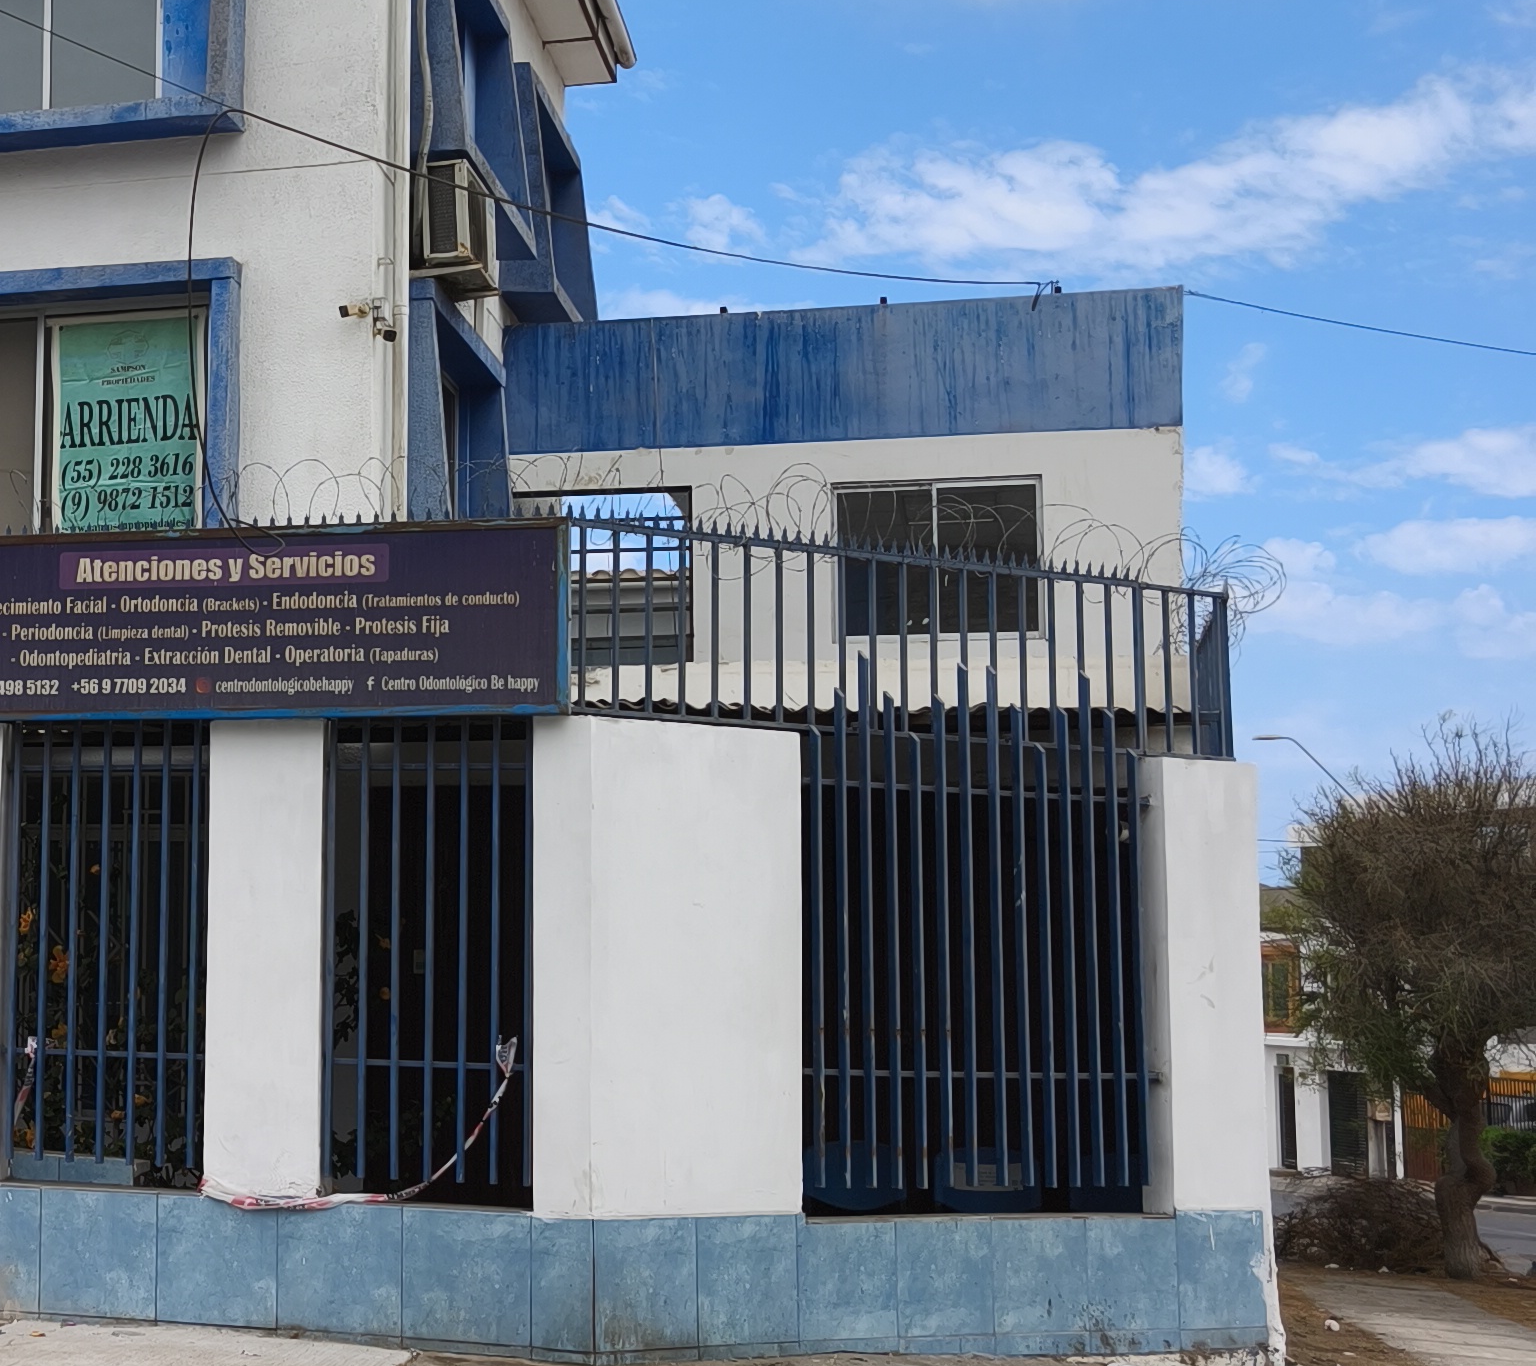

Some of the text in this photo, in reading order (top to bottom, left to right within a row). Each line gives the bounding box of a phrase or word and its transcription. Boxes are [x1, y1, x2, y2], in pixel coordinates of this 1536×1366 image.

[101, 375, 155, 386] PROPIEDADES
[111, 364, 146, 374] SAMPSON
[60, 393, 198, 449] ARRIENDA
[61, 453, 195, 491] (55) 228 3616
[61, 485, 194, 522] (9) 9872 1512
[76, 550, 376, 583] Atenciones y Servicios
[66, 596, 107, 614] Facial
[120, 594, 198, 614] Ortodoncia
[202, 596, 260, 614] (Brackets)
[272, 590, 357, 611] Endodoncia
[362, 593, 442, 610] (Tratamientos
[444, 592, 459, 606] de
[462, 591, 520, 608] conducto)
[11, 615, 449, 642] Periodoncia (Limpieza dental) Protesis Removible Protesis Fija
[20, 644, 439, 670] Odontopediatria Extracción Dental Operatoria (Tapaduras)
[26, 679, 59, 696] 5132
[71, 678, 99, 695] +56
[101, 678, 112, 694] 9
[114, 678, 149, 694] 7709
[149, 677, 187, 694] 2034
[381, 676, 416, 690] Centro
[490, 674, 505, 690] Be
[507, 674, 540, 692] happy
